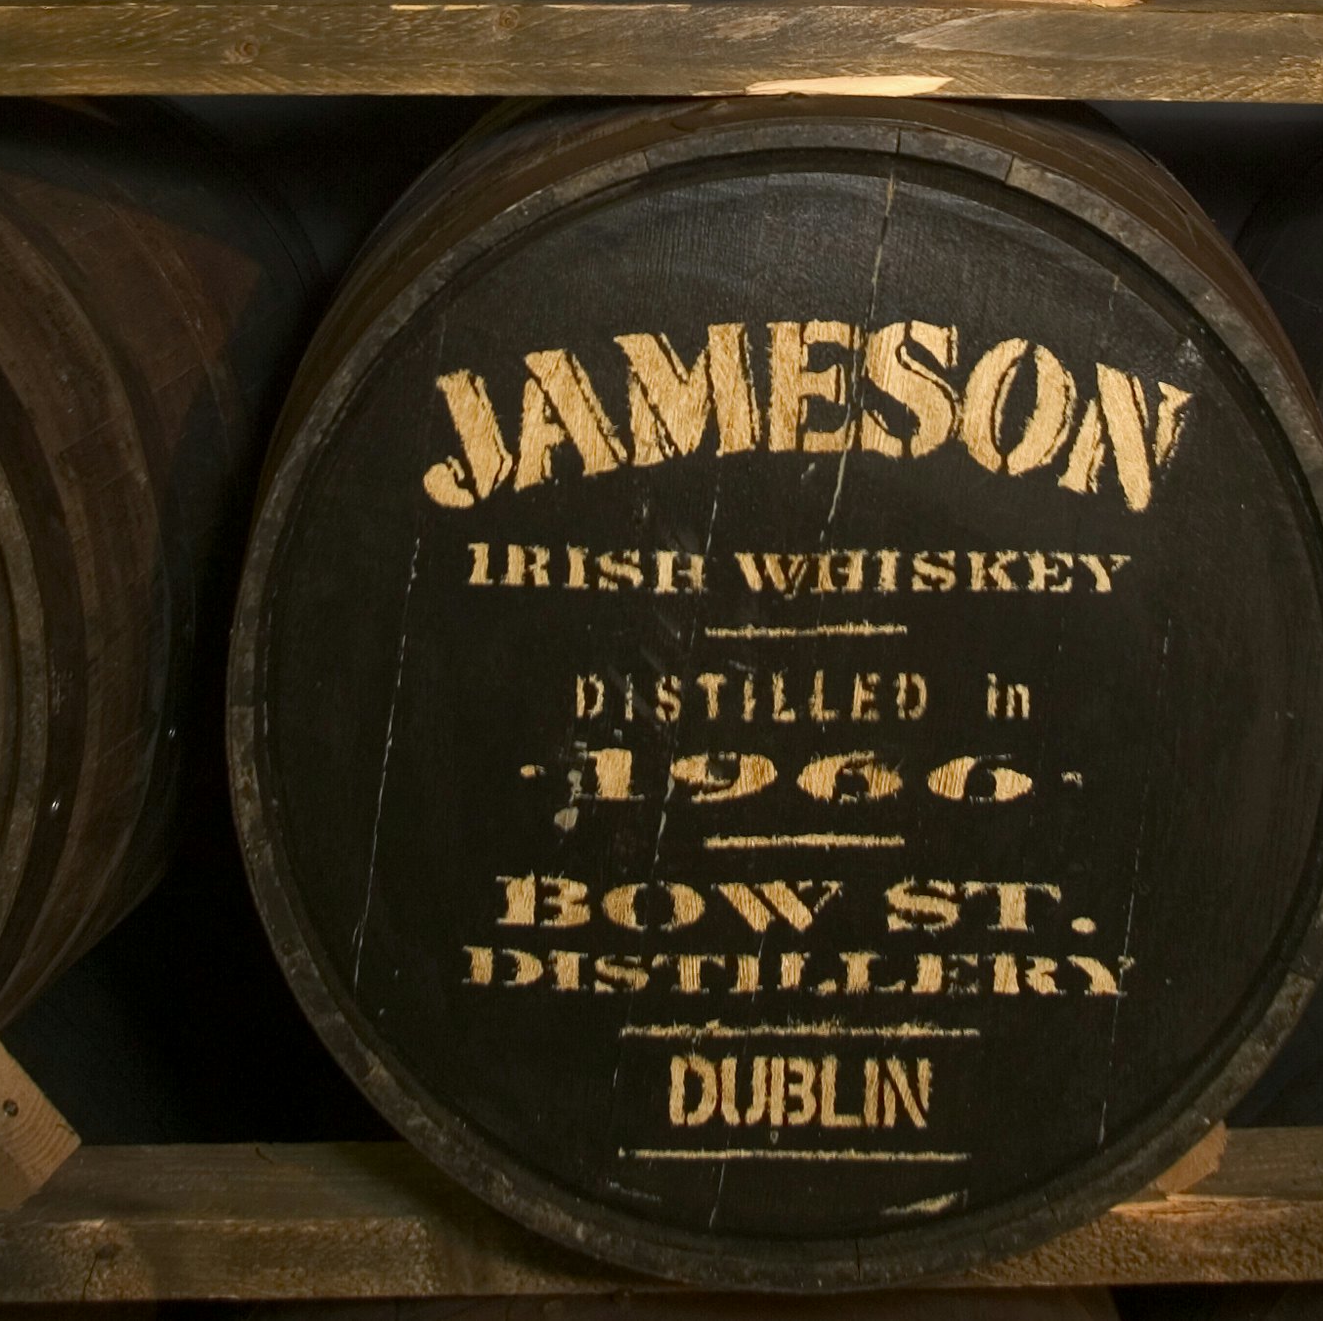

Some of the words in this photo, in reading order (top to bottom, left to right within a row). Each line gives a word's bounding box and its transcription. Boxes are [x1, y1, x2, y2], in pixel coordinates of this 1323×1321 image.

[422, 319, 1194, 514] JAMESON
[466, 542, 707, 593] IRISH
[734, 548, 1133, 599] WHISKEY
[574, 673, 930, 723] DISTILLED
[984, 673, 1031, 719] in
[495, 874, 844, 930] BOW
[884, 877, 1098, 933] ST.
[461, 943, 1136, 997] DISTILLERY
[668, 1056, 934, 1129] DUBLIN
